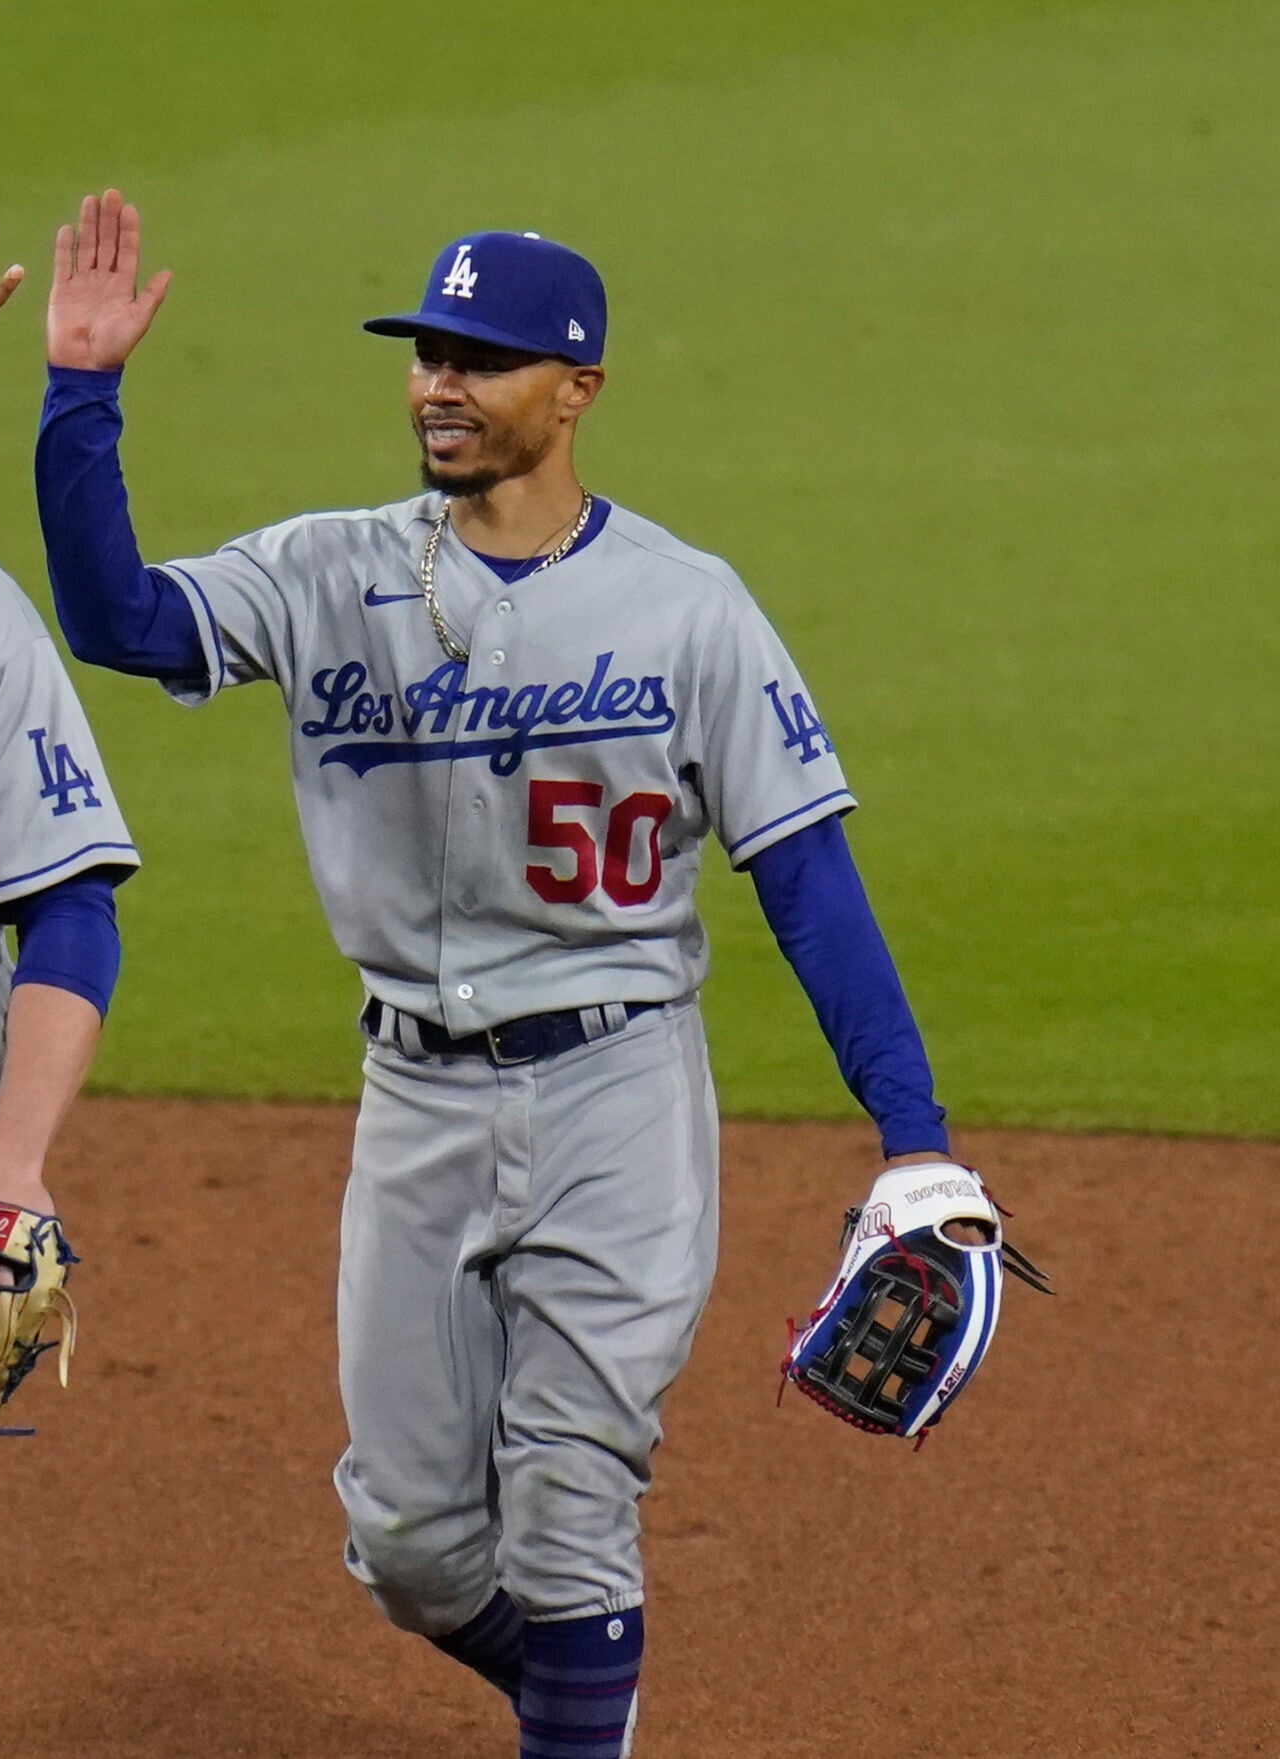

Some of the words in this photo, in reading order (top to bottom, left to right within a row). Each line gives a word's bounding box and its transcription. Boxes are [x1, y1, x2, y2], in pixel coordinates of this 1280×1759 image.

[442, 245, 478, 299] LA
[302, 660, 394, 738] Los
[403, 650, 676, 777] Angeles
[763, 679, 838, 764] LA
[27, 727, 102, 817] LA
[526, 779, 673, 908] 50
[904, 1179, 980, 1205] Wilson
[936, 1361, 966, 1403] A2K
